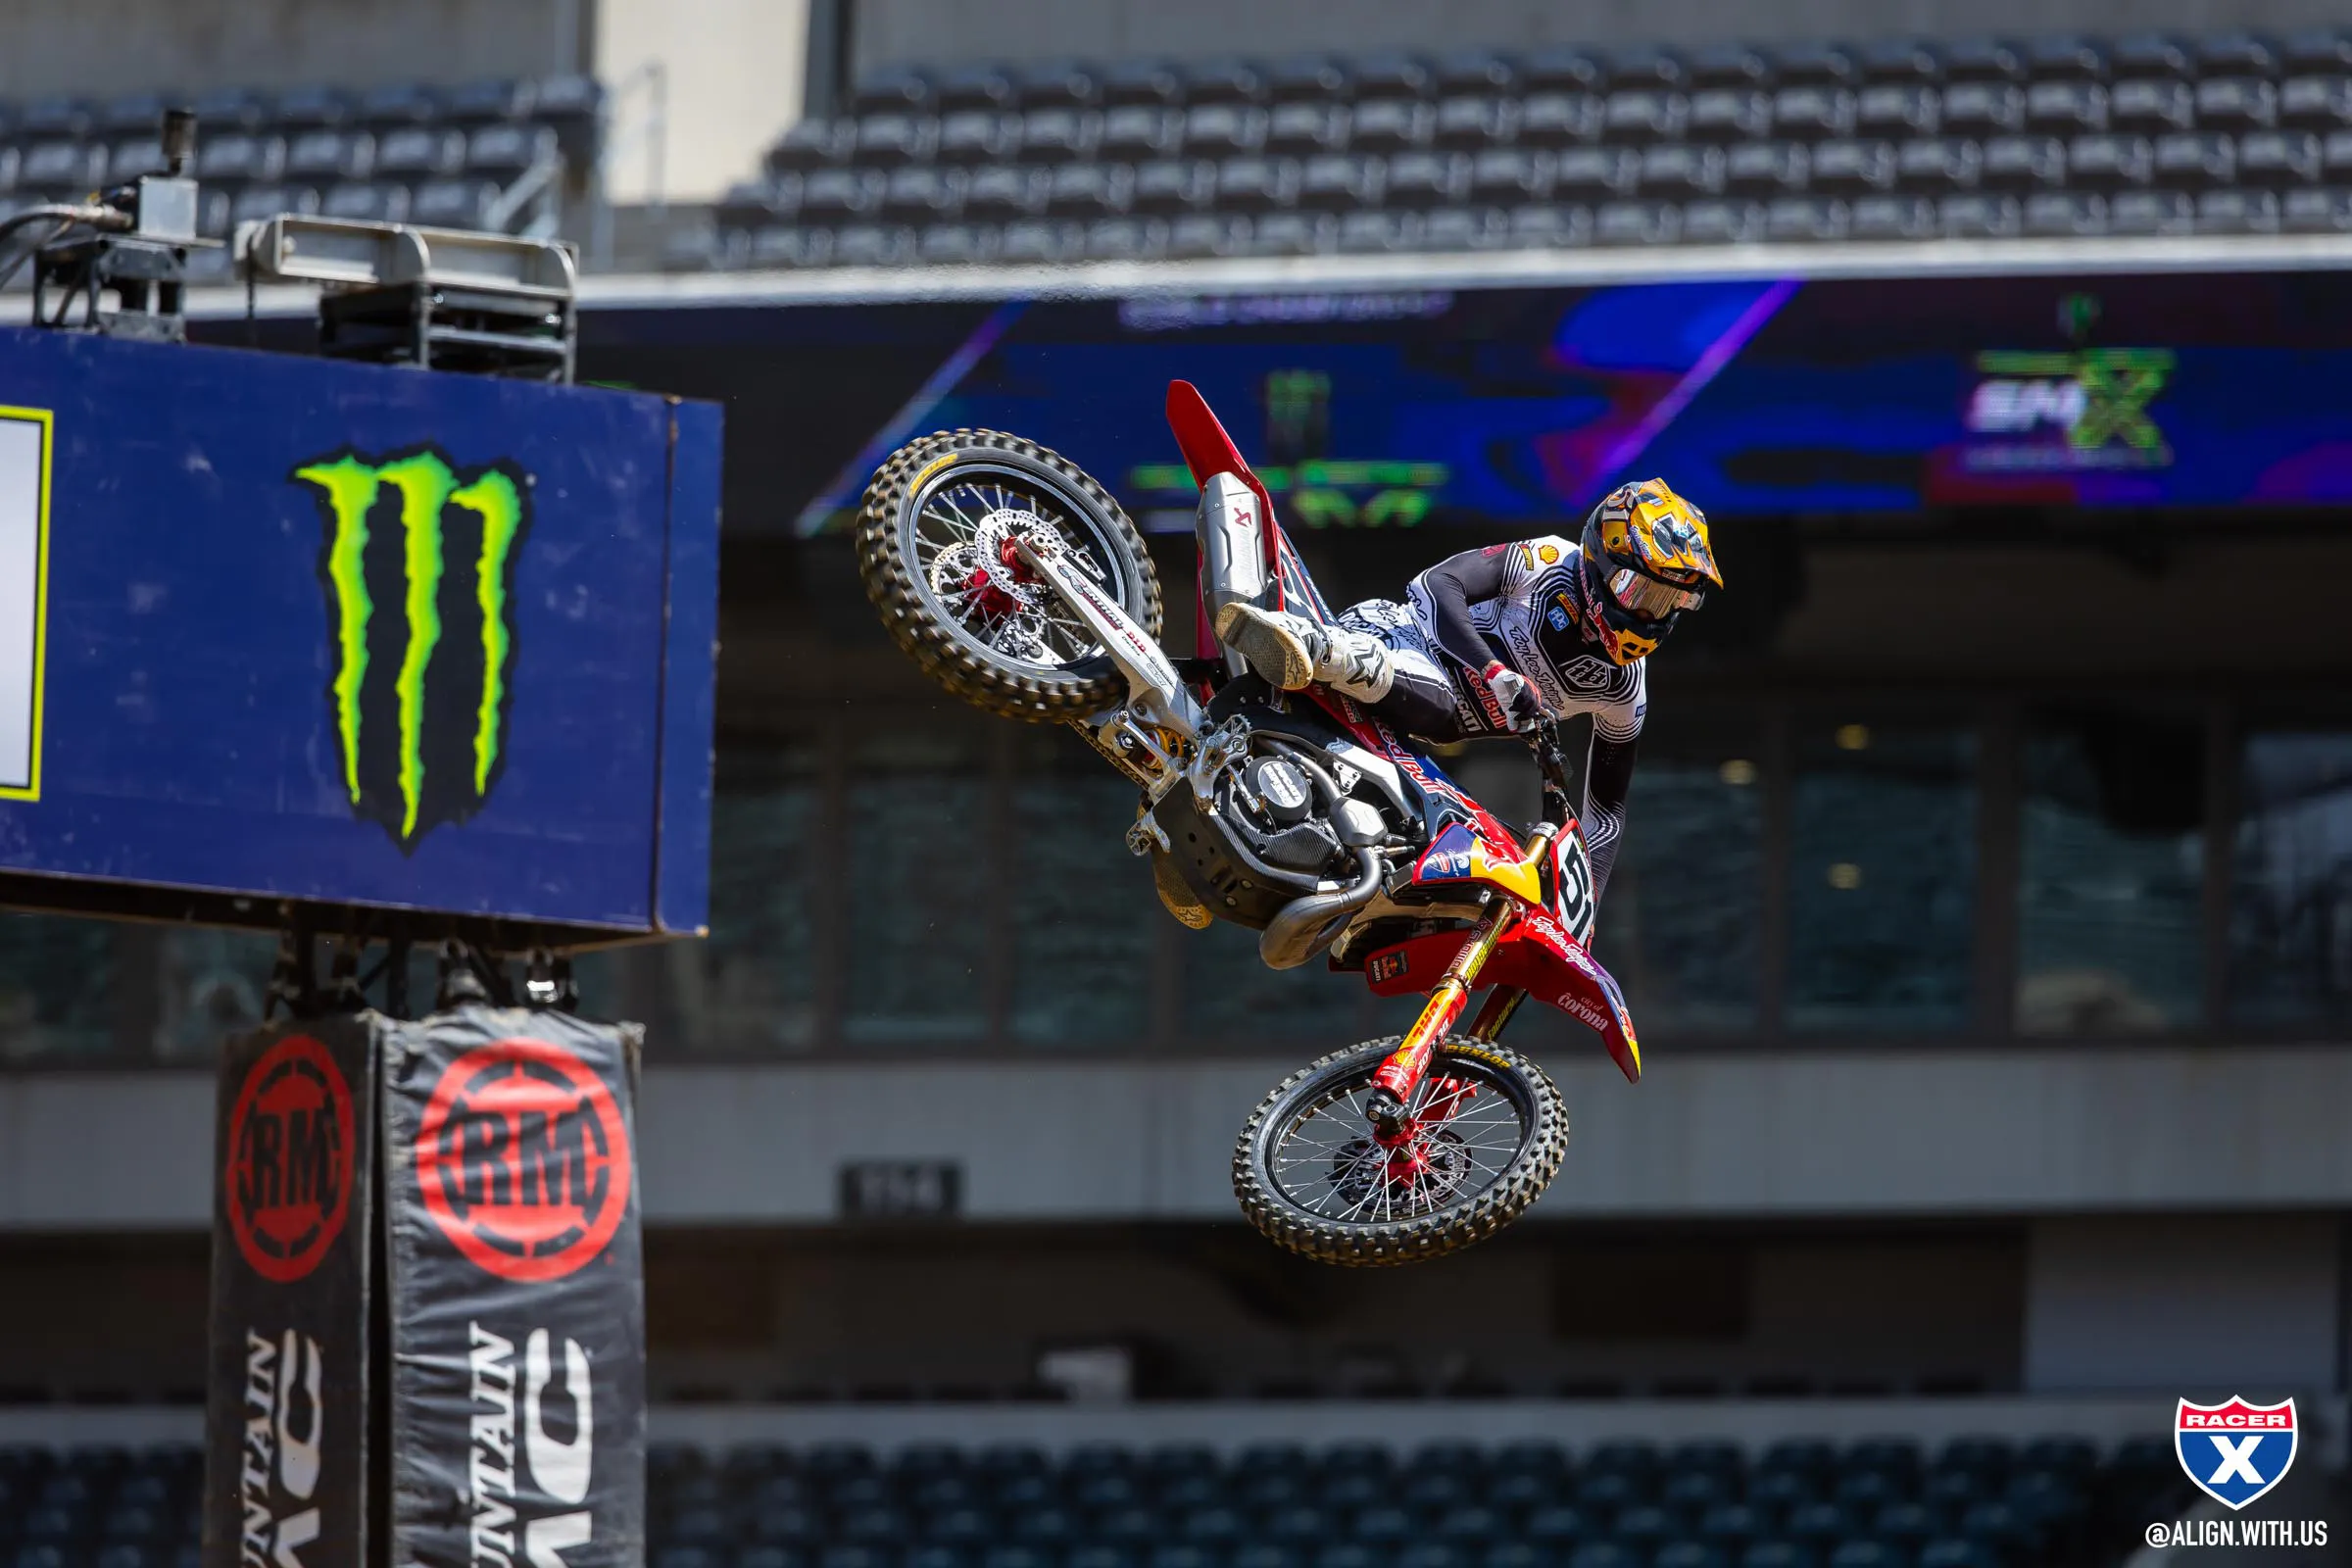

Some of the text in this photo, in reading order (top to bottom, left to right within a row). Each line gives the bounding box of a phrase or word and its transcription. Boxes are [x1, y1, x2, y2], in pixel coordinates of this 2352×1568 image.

[1550, 608, 1568, 629] PPG
[1481, 694, 1507, 729] Bull
[1396, 760, 1445, 794] Bull
[1412, 1001, 1440, 1039] DHL
[1558, 994, 1608, 1031] corona
[1446, 1045, 1511, 1068] DUNLOP
[462, 1108, 586, 1207] RM
